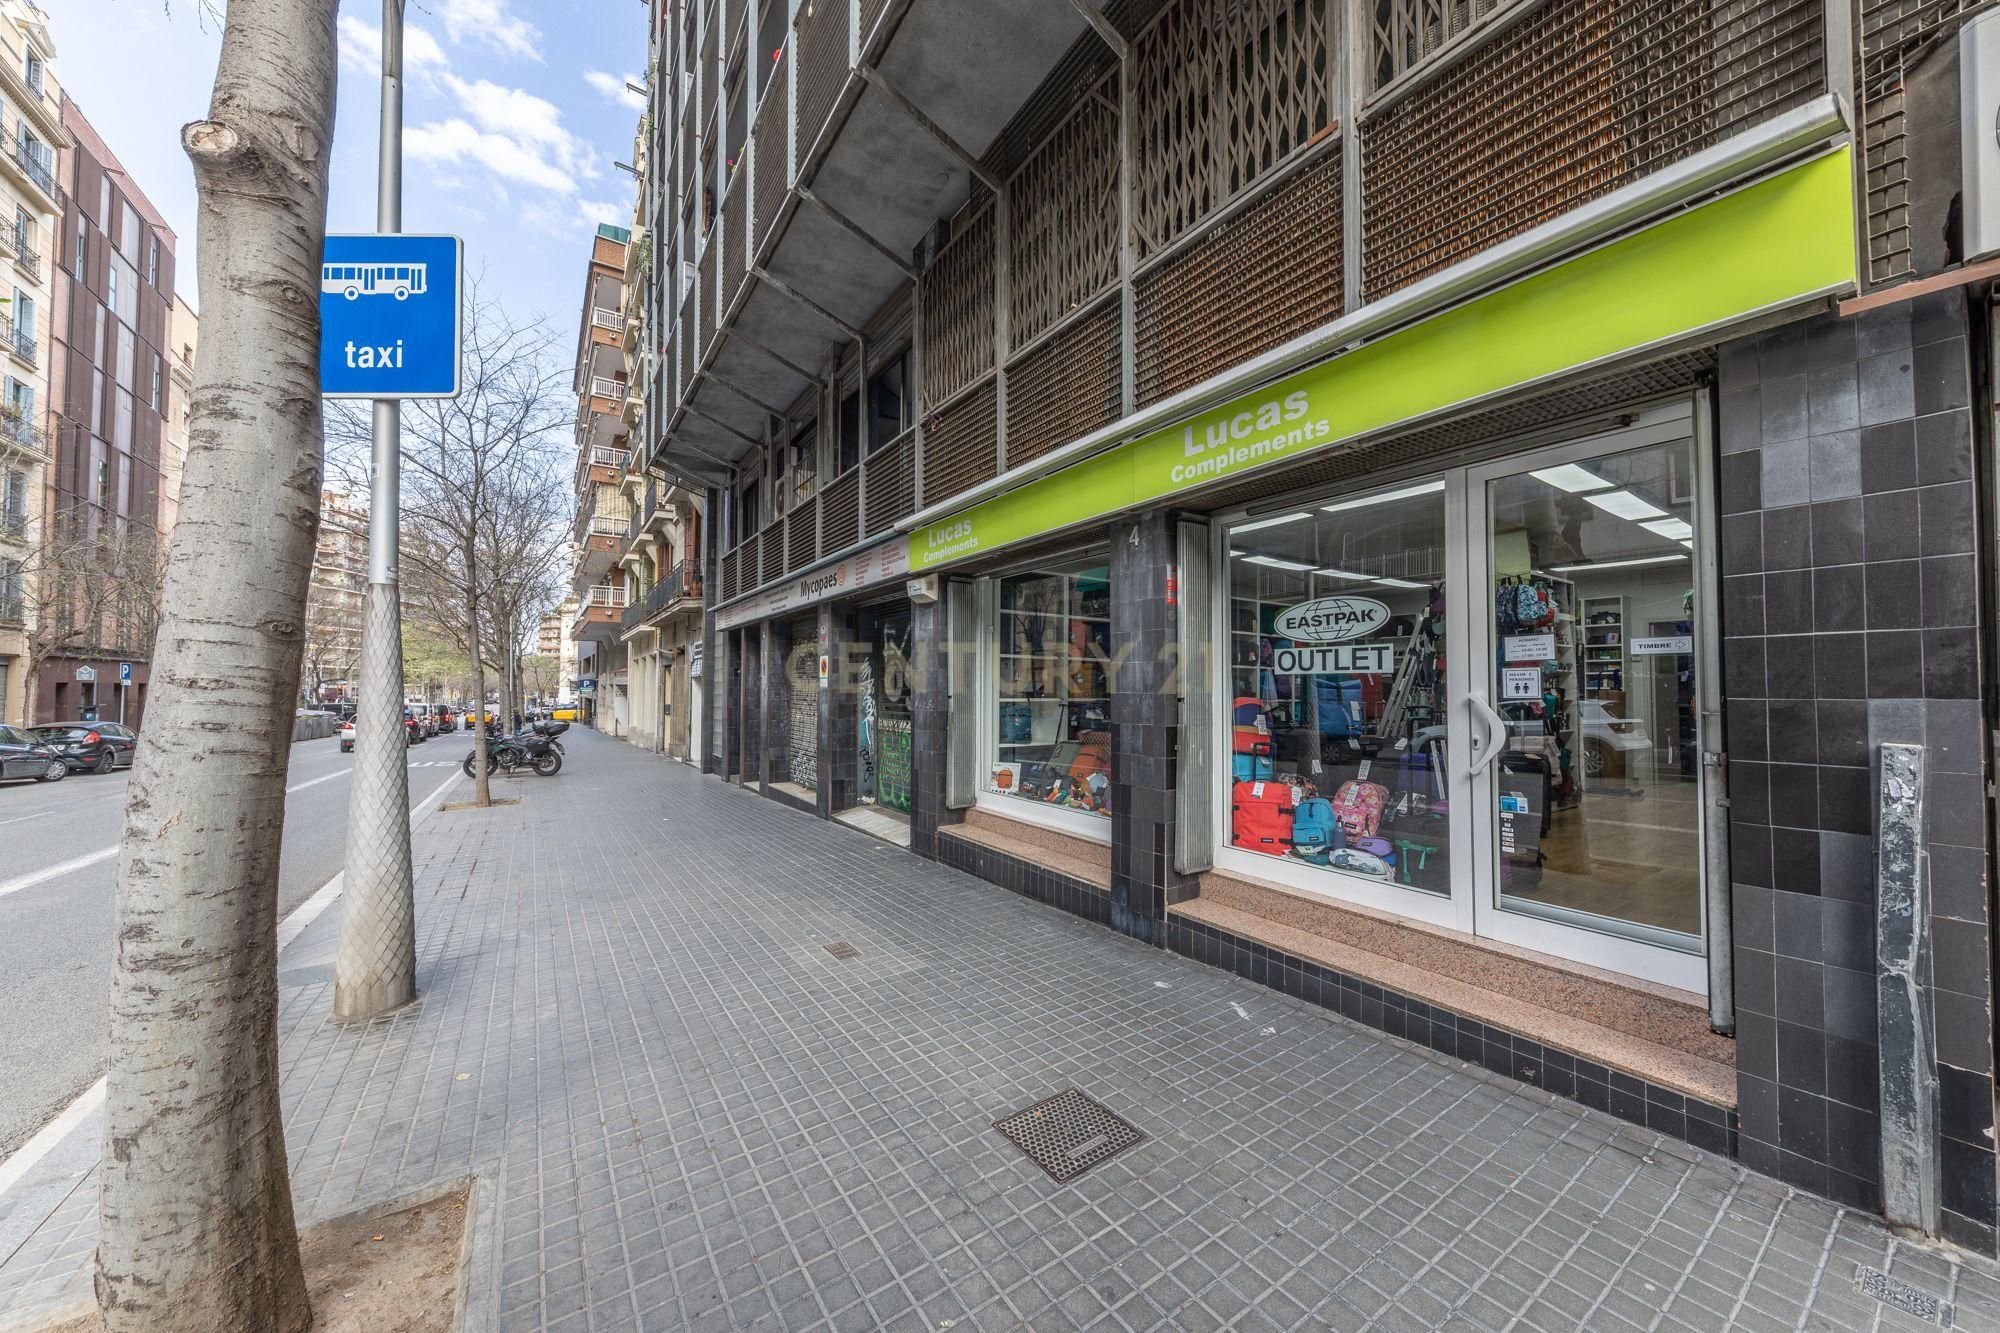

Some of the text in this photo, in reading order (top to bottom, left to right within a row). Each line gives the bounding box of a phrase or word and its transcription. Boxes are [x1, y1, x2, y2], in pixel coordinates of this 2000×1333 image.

[344, 339, 403, 369] taxi
[1184, 390, 1309, 458] Lucas
[1170, 419, 1330, 483] Complements
[928, 518, 972, 548] Lucas
[1129, 525, 1140, 546] 4
[923, 536, 979, 563] Complements
[800, 572, 838, 600] Mycopaes
[1286, 608, 1376, 630] EASTPAK
[1277, 646, 1390, 672] OUTLET
[1638, 642, 1672, 650] TIMBRE
[583, 680, 590, 688] P
